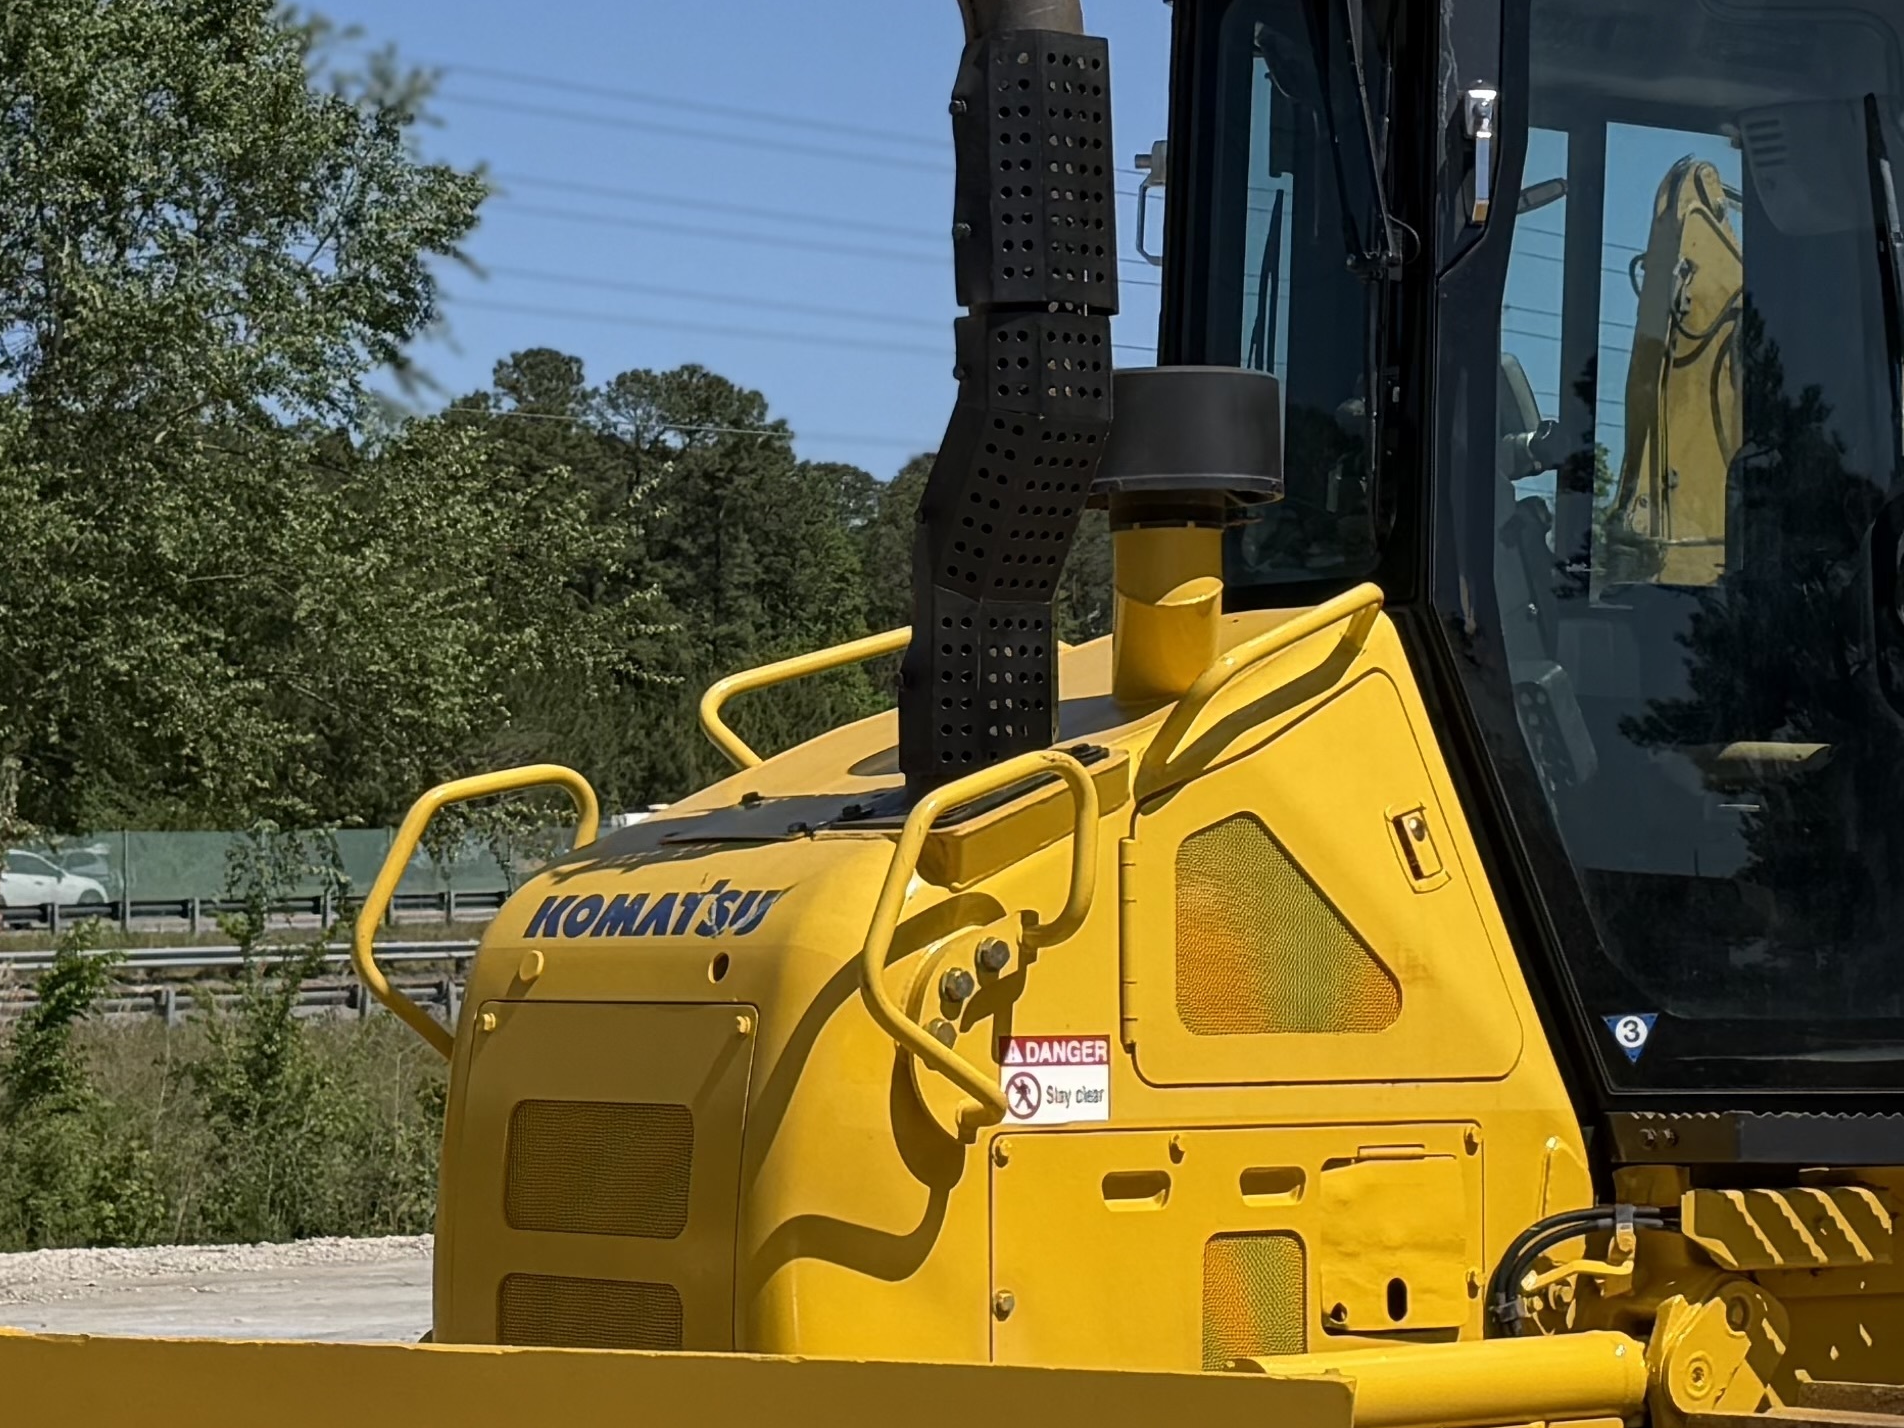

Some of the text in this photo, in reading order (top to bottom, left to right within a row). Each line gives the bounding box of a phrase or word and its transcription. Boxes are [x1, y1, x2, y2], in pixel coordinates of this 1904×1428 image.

[522, 879, 785, 938] KOMATSU
[1622, 1019, 1640, 1043] 3
[1025, 1040, 1108, 1063] DANGER
